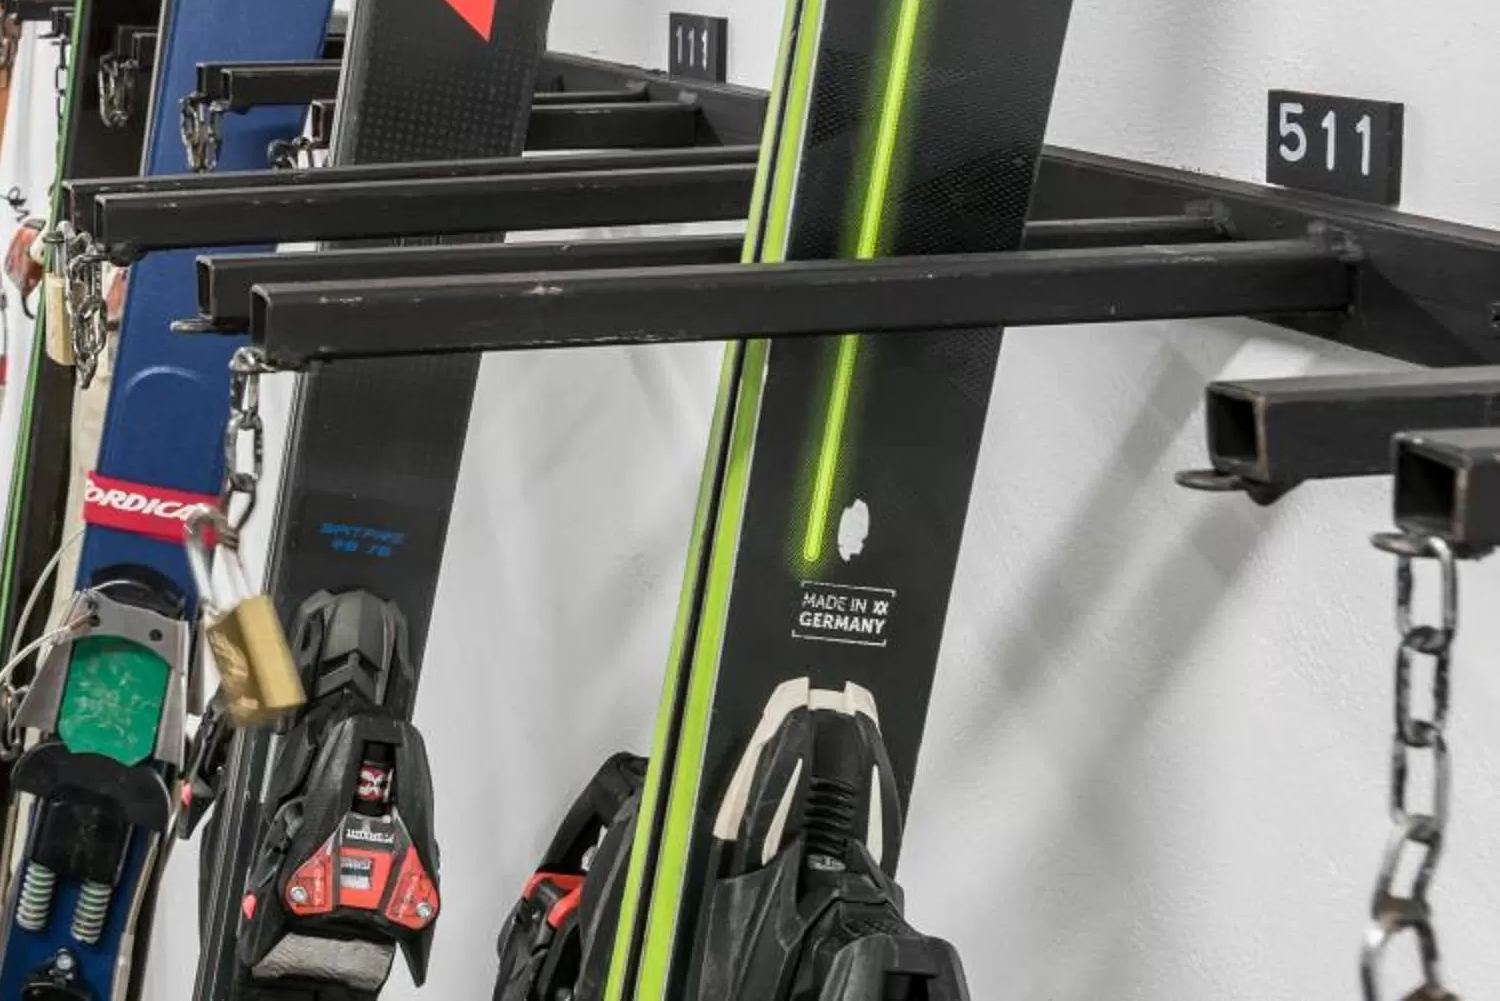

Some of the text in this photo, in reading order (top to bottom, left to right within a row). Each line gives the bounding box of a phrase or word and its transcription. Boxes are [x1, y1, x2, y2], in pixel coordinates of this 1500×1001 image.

[675, 25, 709, 71] 111
[1279, 102, 1372, 176] 511
[84, 478, 206, 521] ORDICA
[799, 612, 887, 635] GERMANY
[802, 592, 867, 613] MADE IN
